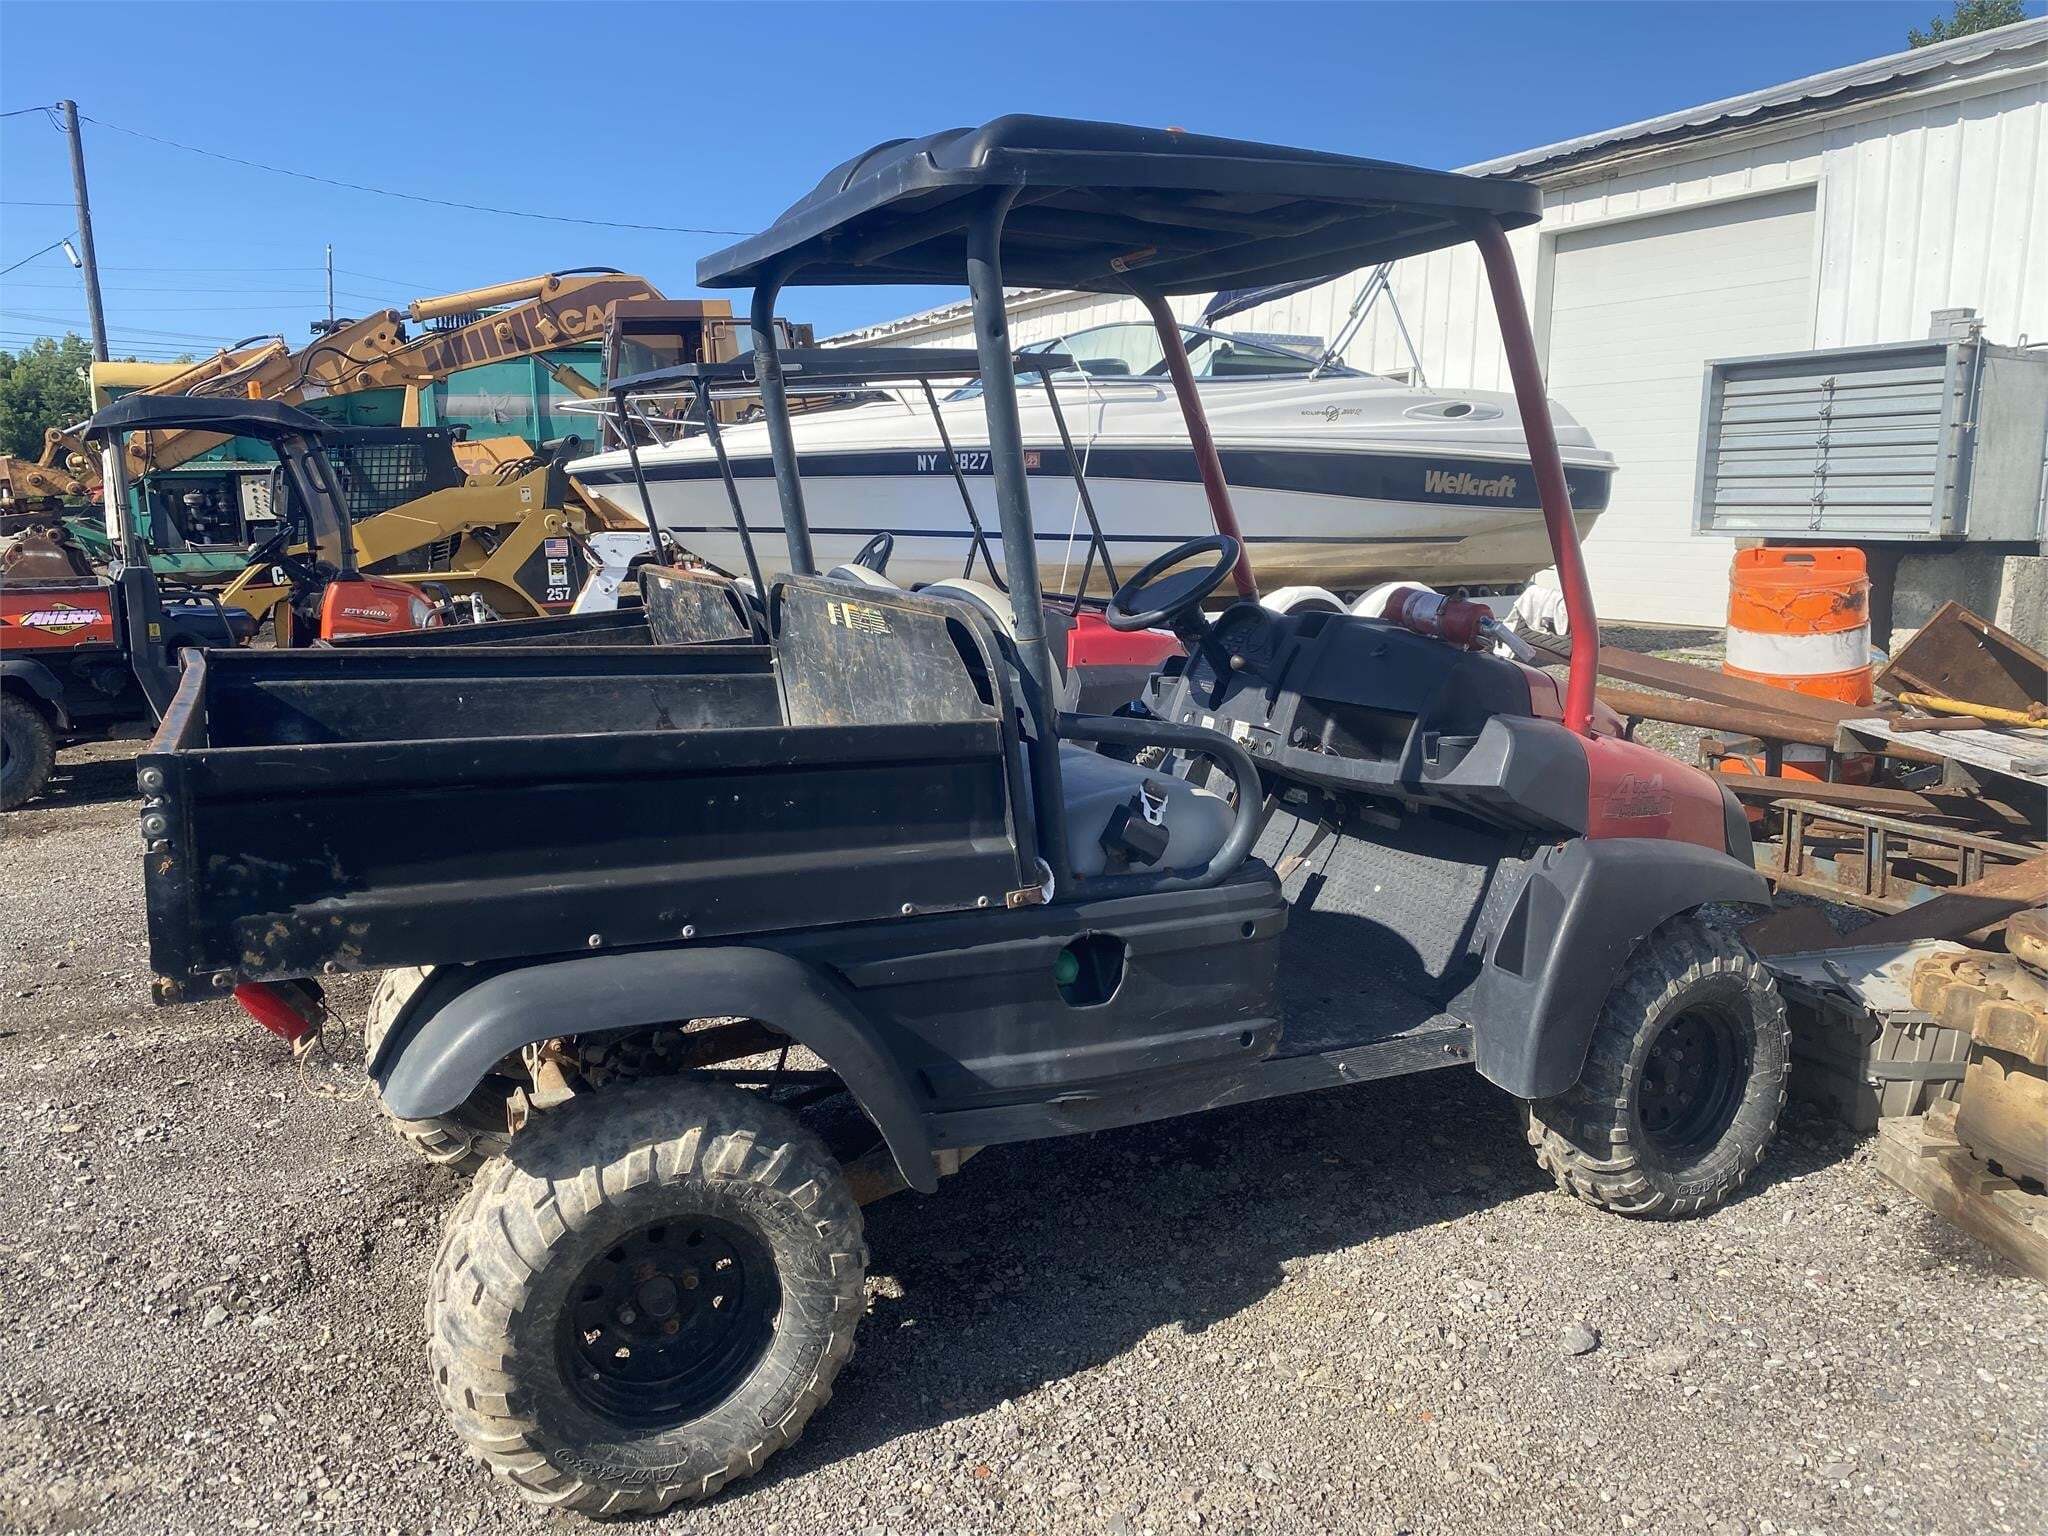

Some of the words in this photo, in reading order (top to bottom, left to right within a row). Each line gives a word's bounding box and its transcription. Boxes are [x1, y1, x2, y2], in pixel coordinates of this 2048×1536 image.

[558, 305, 605, 335] CA
[917, 454, 938, 471] NY
[949, 453, 989, 470] 827
[1424, 470, 1517, 498] Wellcraft
[546, 587, 571, 601] 257
[22, 609, 103, 626] AHERN
